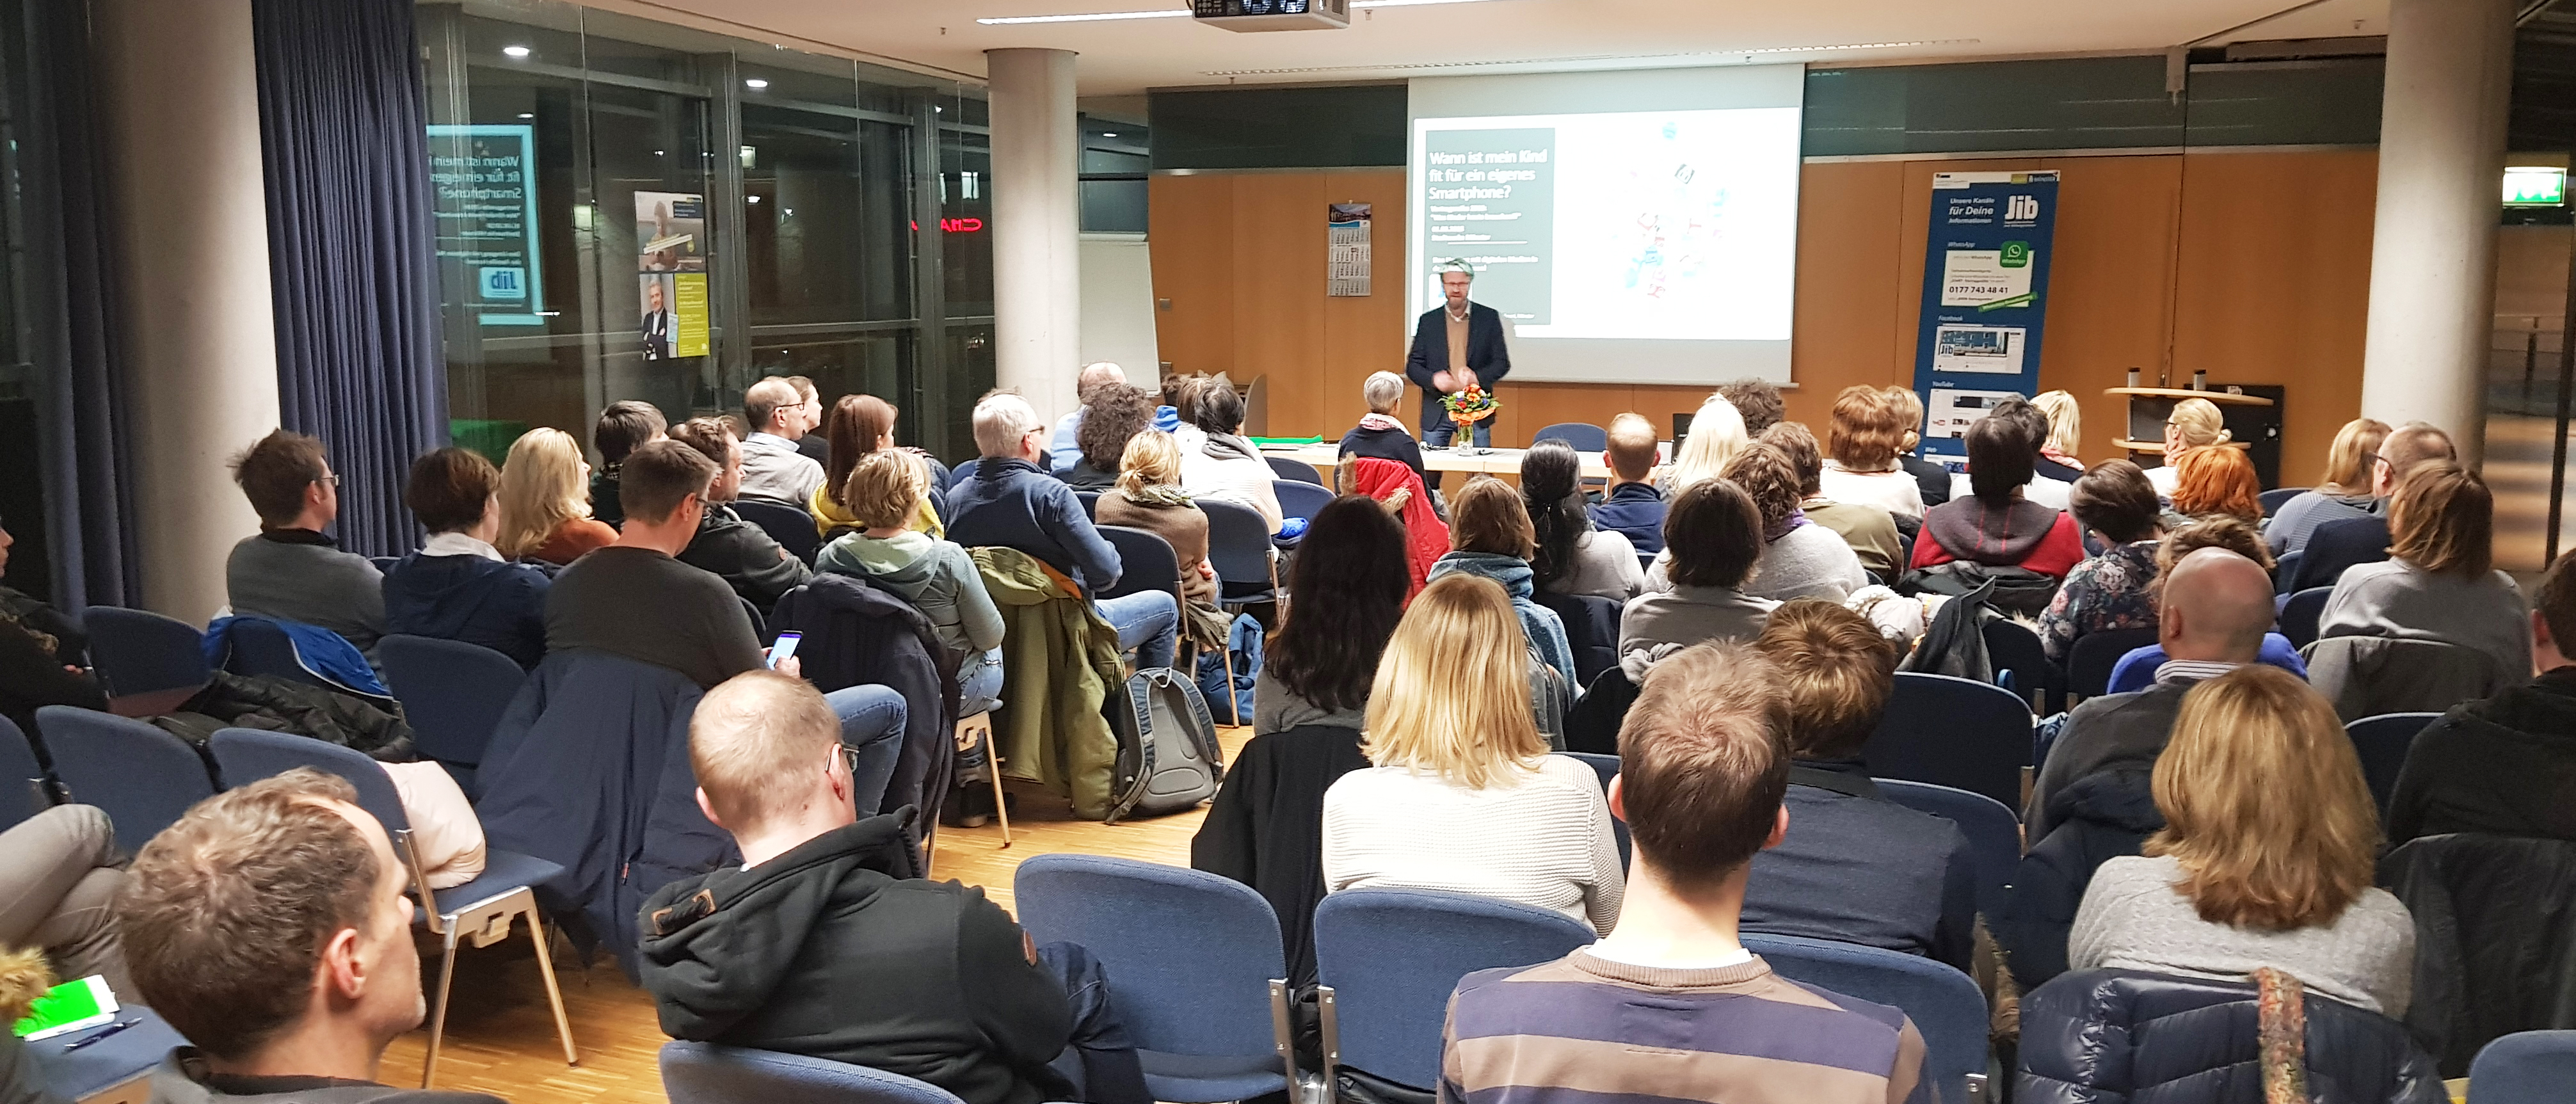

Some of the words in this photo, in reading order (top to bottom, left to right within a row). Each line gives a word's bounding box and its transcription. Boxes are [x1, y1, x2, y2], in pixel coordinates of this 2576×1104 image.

[1429, 152, 1466, 165] Wann
[1468, 151, 1484, 164] ist
[1485, 150, 1517, 164] mein
[1519, 148, 1548, 163] Kind
[1428, 168, 1444, 182] fit
[1445, 168, 1464, 182] für
[1466, 168, 1485, 182] ein
[1487, 168, 1536, 184] eigenes
[1428, 184, 1512, 202] Smartphone?
[1949, 206, 1964, 215] für
[1965, 206, 1994, 215] Deine
[2004, 195, 2039, 220] Jib
[1941, 344, 1953, 354] Jib
